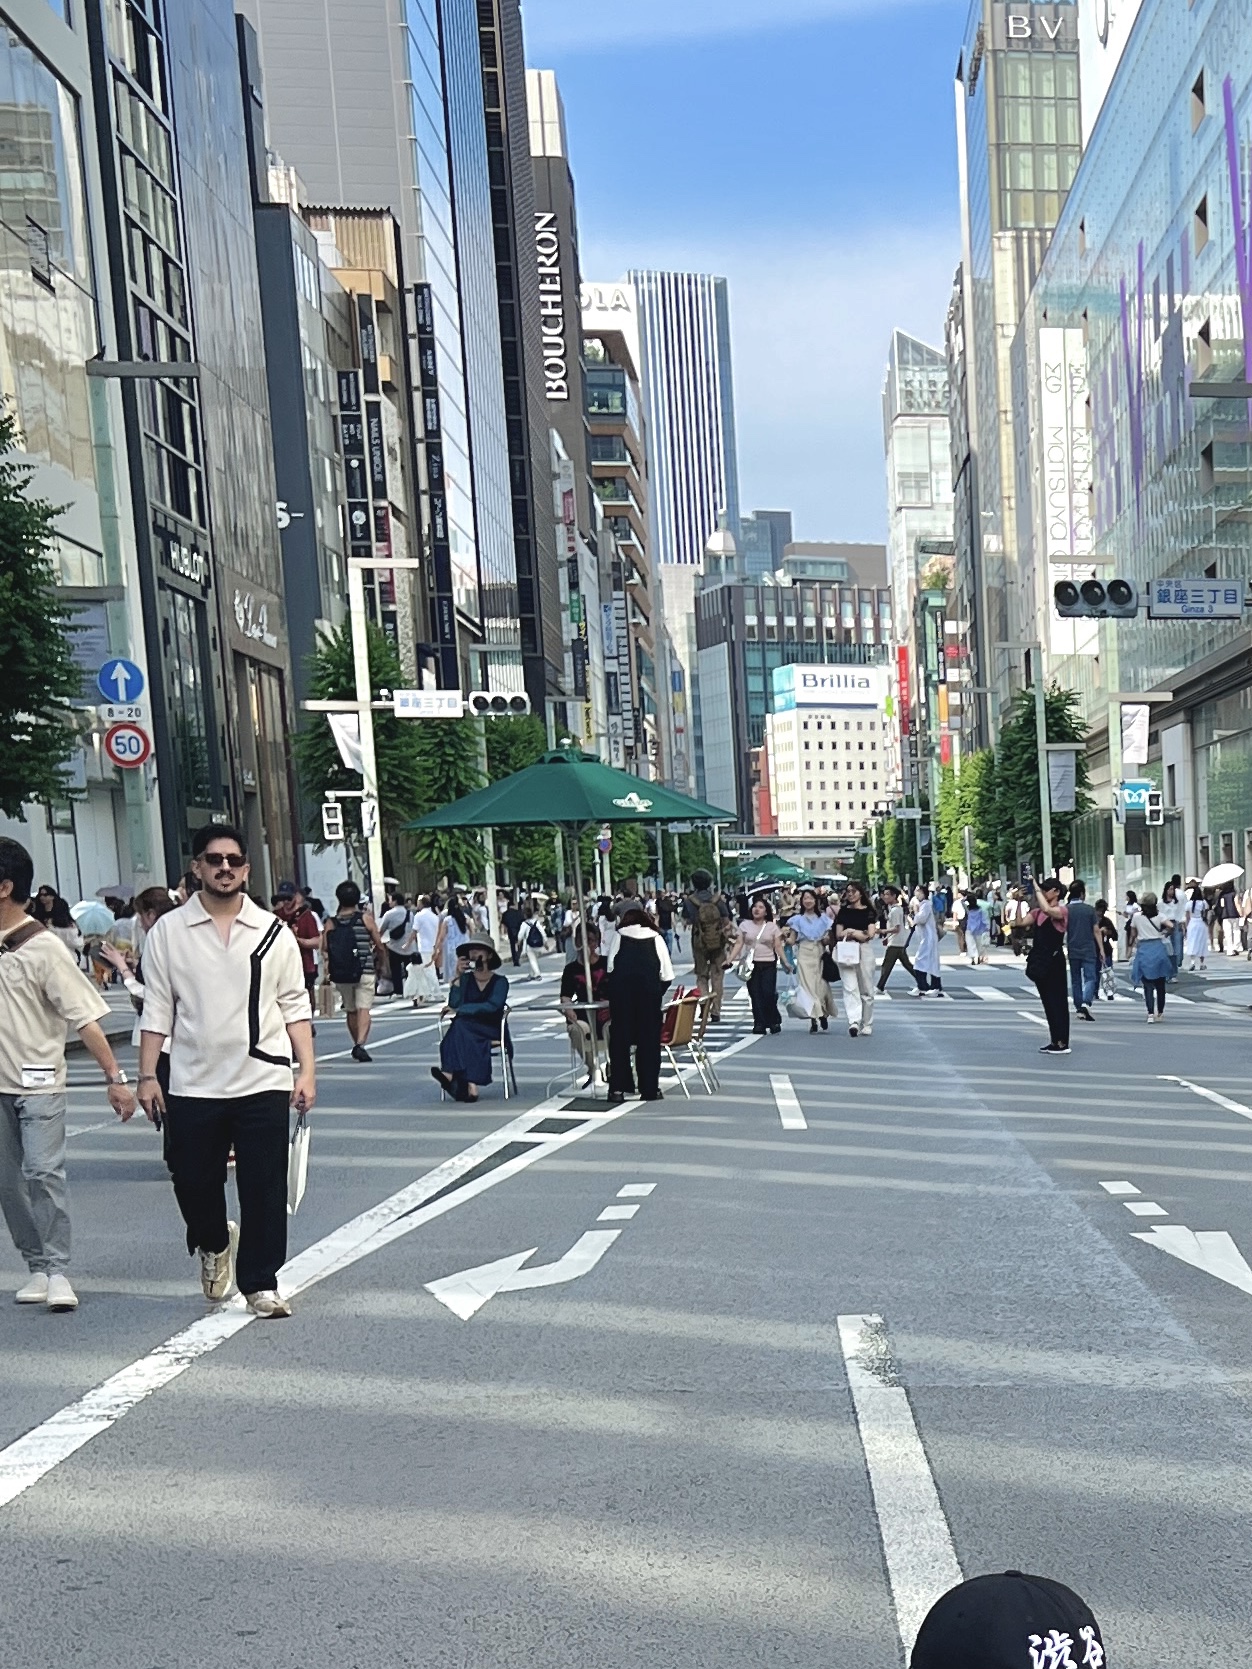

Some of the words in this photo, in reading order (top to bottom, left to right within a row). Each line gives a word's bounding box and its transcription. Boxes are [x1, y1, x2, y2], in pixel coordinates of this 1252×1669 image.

[534, 212, 568, 400] BOUCHERON
[1157, 589, 1238, 604] 銀座三丁目
[1181, 604, 1205, 613] Ginza
[801, 673, 870, 688] Brillia
[115, 735, 141, 756] 50
